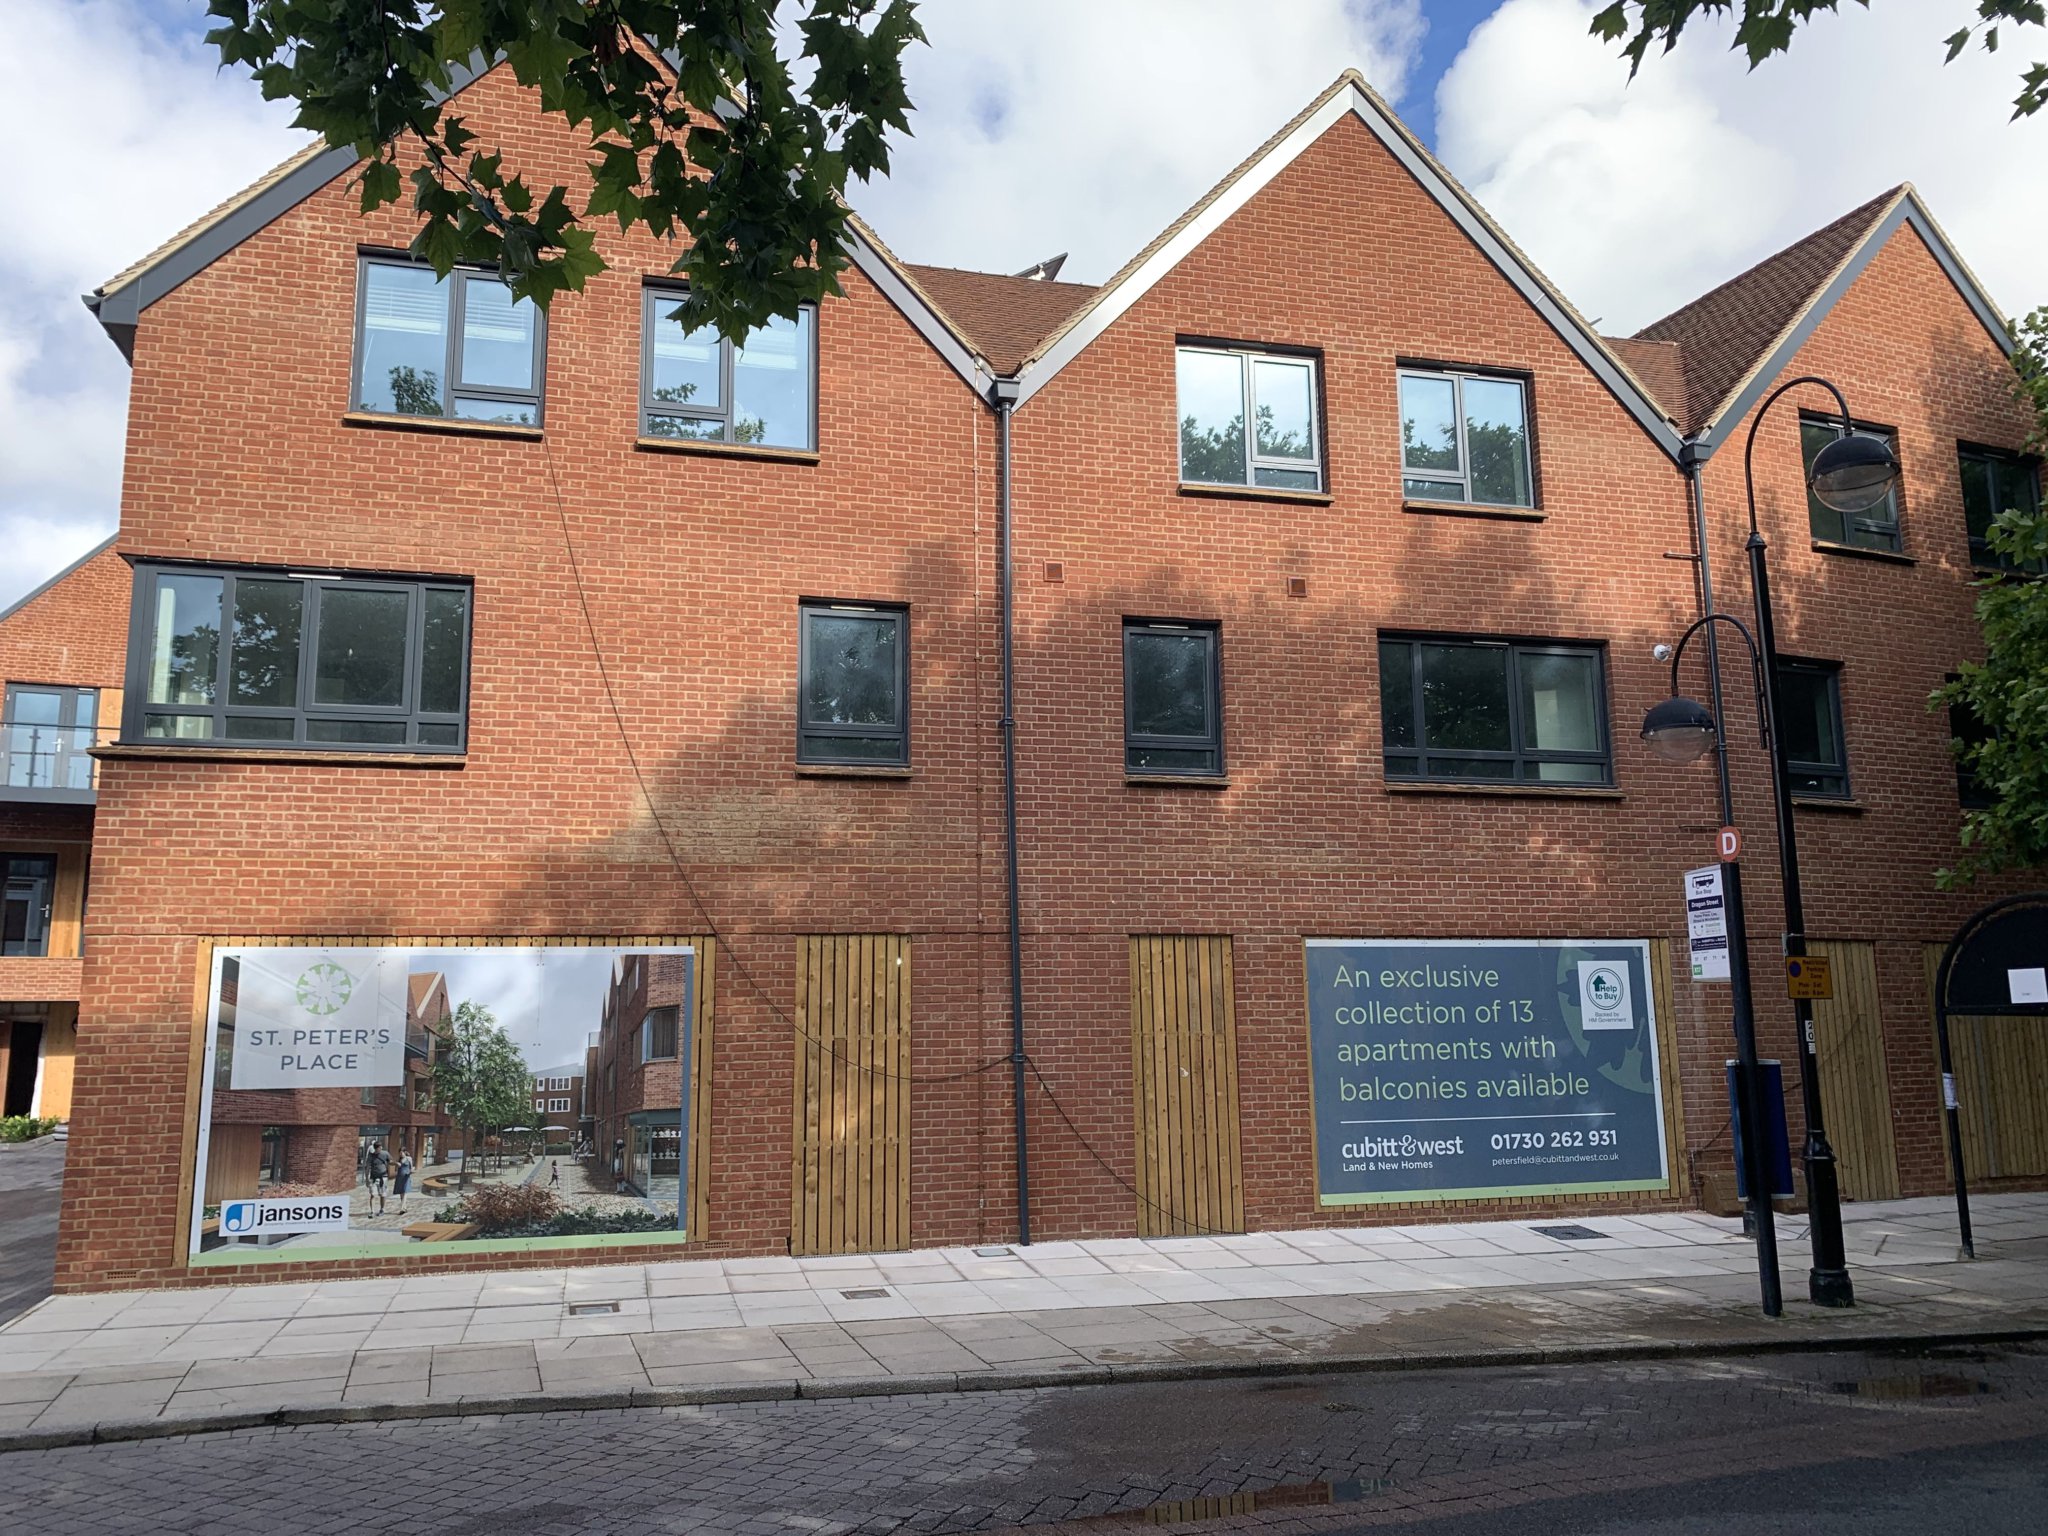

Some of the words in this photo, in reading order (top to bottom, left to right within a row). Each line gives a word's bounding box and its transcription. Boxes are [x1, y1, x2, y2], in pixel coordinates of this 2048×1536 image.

[1722, 832, 1737, 855] D
[1333, 965, 1370, 988] An
[1380, 964, 1499, 988] exclusive
[1600, 985, 1618, 993] Help
[1335, 1001, 1466, 1025] collection
[1475, 1000, 1501, 1023] of
[1508, 1000, 1534, 1023] 13
[250, 1030, 282, 1046] ST.
[293, 1029, 390, 1045] PETER'S
[1337, 1038, 1492, 1066] apartments
[1500, 1034, 1556, 1058] with
[281, 1054, 358, 1070] PLACE
[1340, 1076, 1467, 1101] balconies
[1477, 1072, 1589, 1098] available
[1342, 1135, 1464, 1158] cubitt&west
[1490, 1132, 1545, 1150] 01730
[1550, 1131, 1584, 1147] 262
[1588, 1130, 1617, 1146] 931
[1343, 1162, 1366, 1172] Land
[1369, 1162, 1376, 1171] &
[1378, 1162, 1399, 1170] New
[1401, 1161, 1433, 1170] Homes
[1492, 1152, 1620, 1167] petersfield@cubittandwest.co.uk
[257, 1205, 343, 1226] jansons
